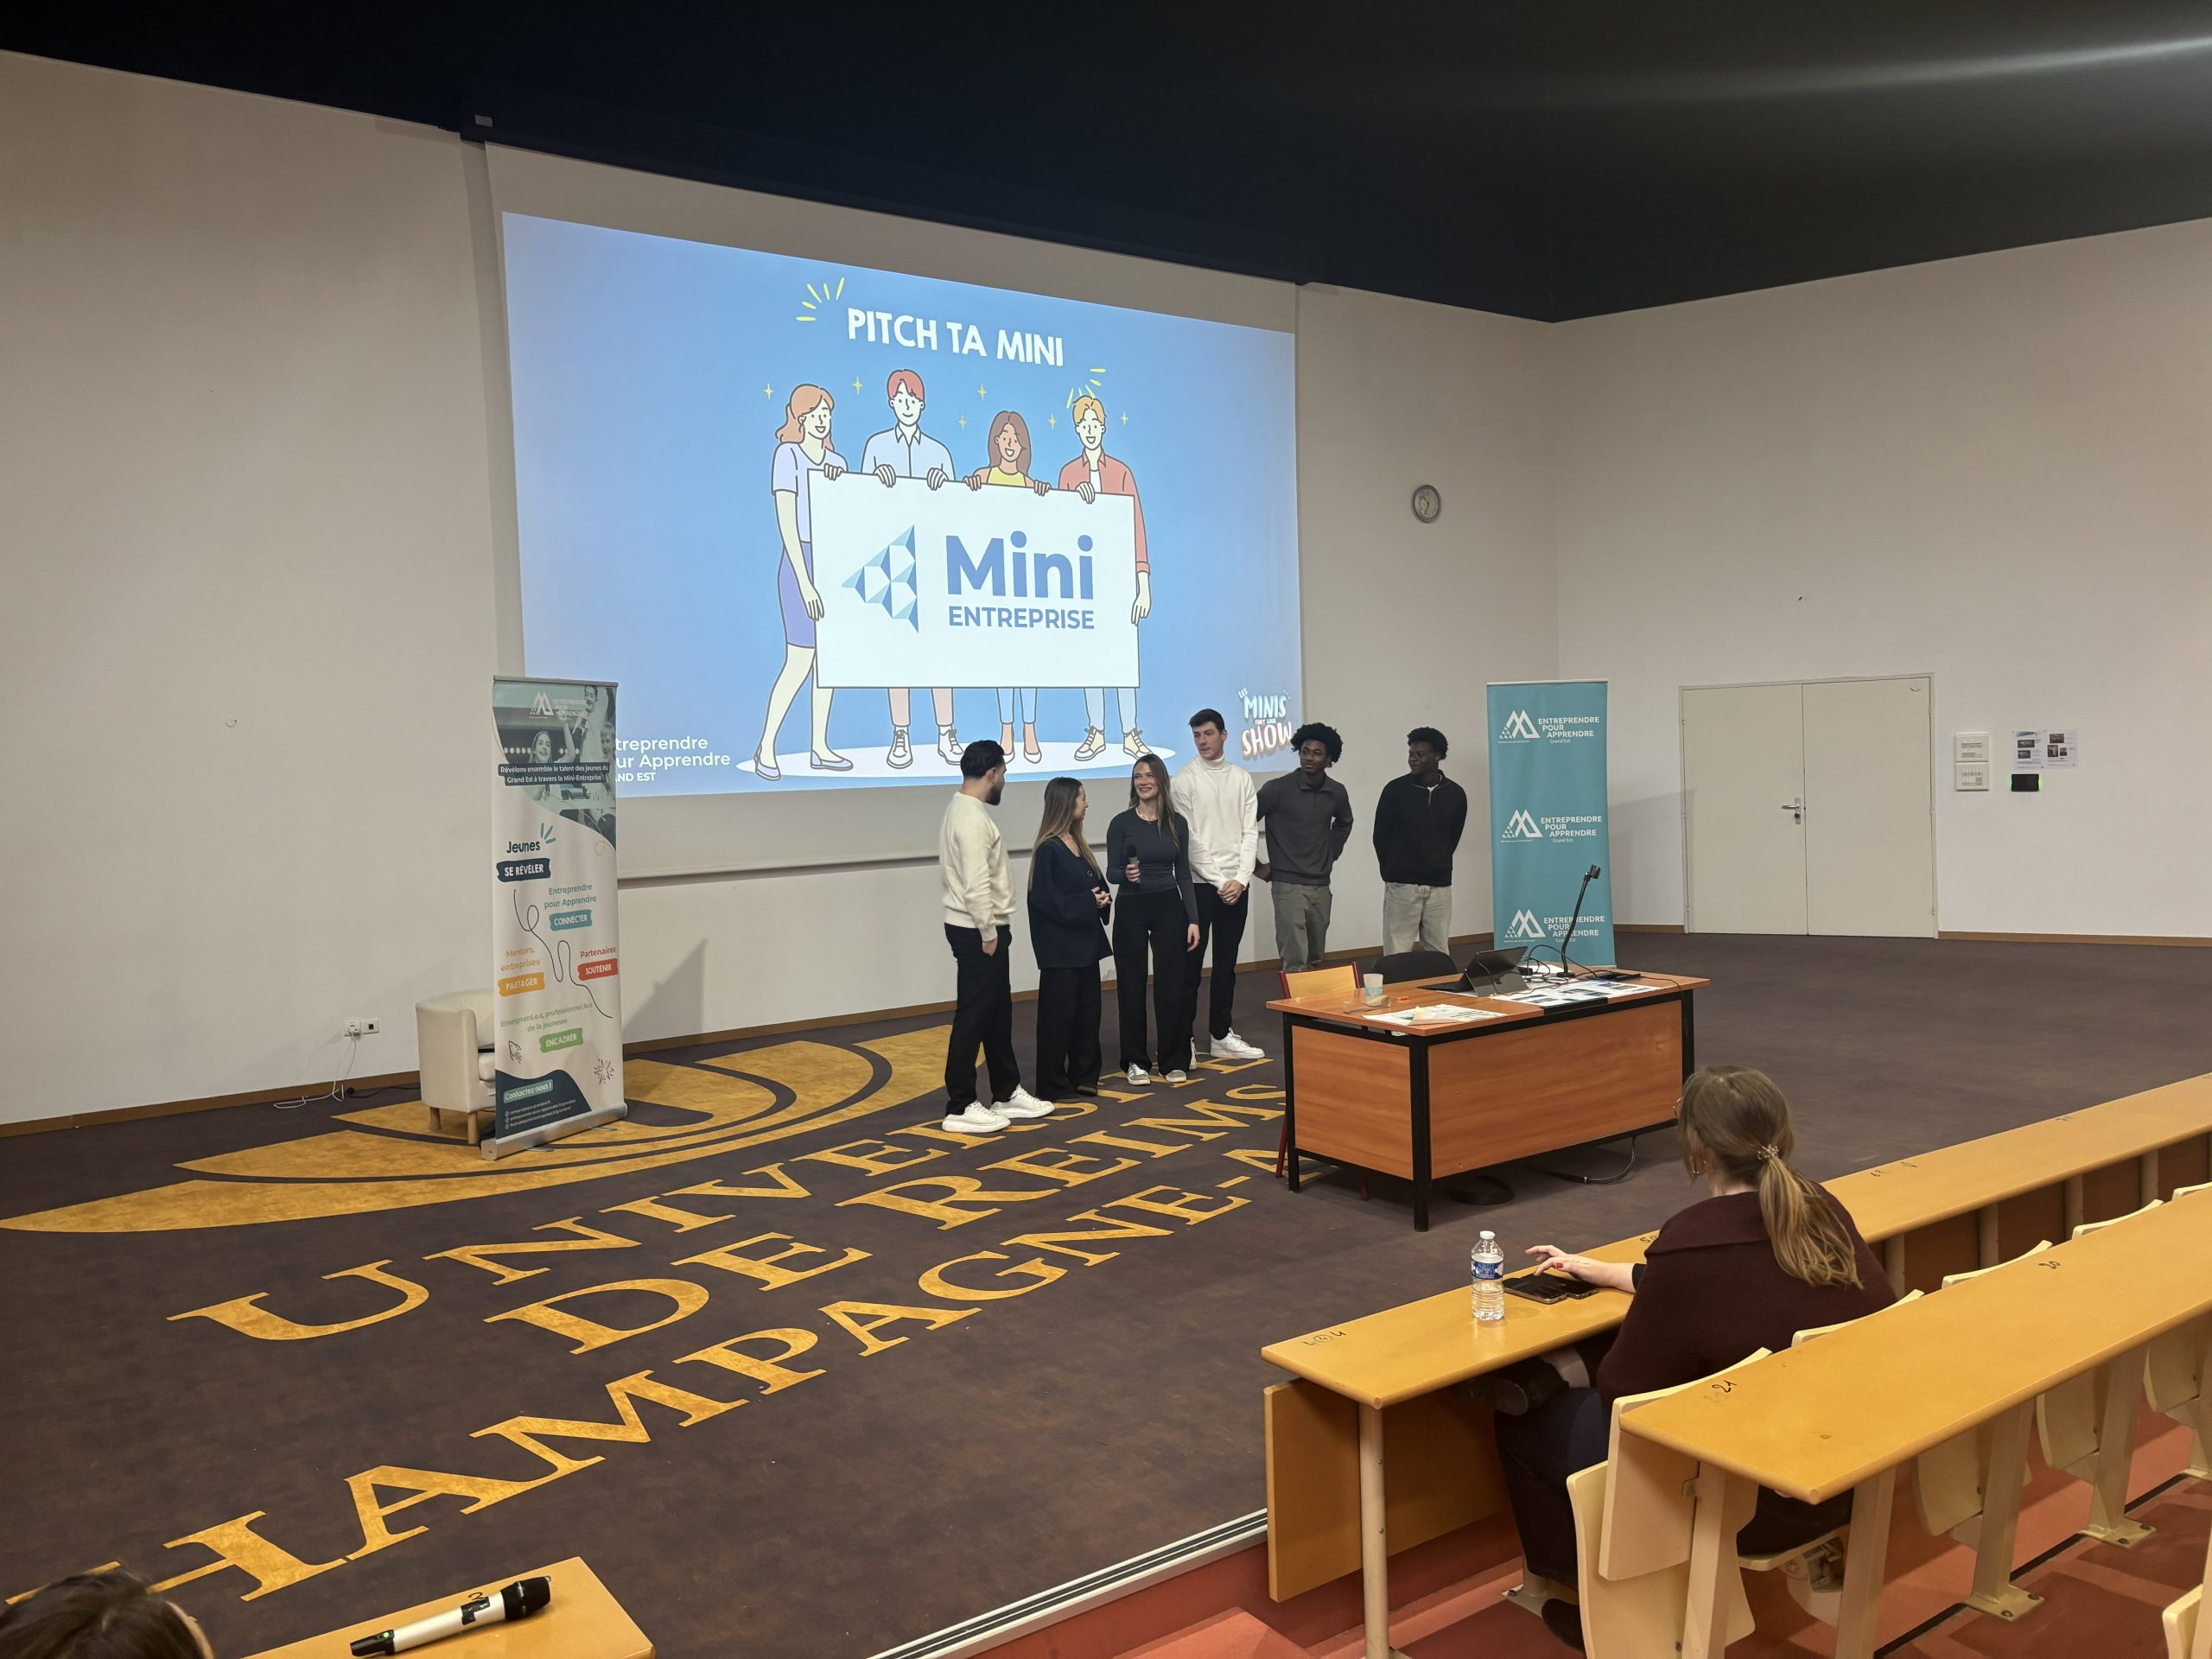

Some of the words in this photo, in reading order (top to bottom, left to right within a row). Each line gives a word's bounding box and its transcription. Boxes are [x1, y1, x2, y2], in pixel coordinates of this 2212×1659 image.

[848, 308, 938, 350] PITCH
[946, 321, 987, 357] TA
[996, 329, 1064, 366] MINI
[946, 531, 1093, 600] Mini
[949, 606, 1094, 629] ENTREPRISE
[1244, 695, 1287, 718] MINIS
[1538, 716, 1600, 725] ENTREPRENDRE
[615, 735, 708, 753] treprendre
[1242, 721, 1293, 755] SHOW
[616, 757, 634, 768] ur
[639, 752, 730, 770] Apprendre
[637, 772, 656, 781] EST
[506, 841, 540, 853] Jeunes
[505, 868, 513, 876] SE
[549, 884, 592, 895] Entreprendre
[563, 895, 597, 907] Apprendre
[554, 914, 588, 925] CONNECTER
[581, 946, 616, 958] Partenaires
[501, 958, 540, 971] entreprises
[586, 964, 612, 975] SOUTENIR
[506, 978, 537, 990] PARTAGER
[543, 1019, 568, 1030] jeunesse
[546, 1033, 577, 1047] ENCADRER
[483, 1232, 873, 1354] DE
[834, 1084, 1286, 1230] REIMS
